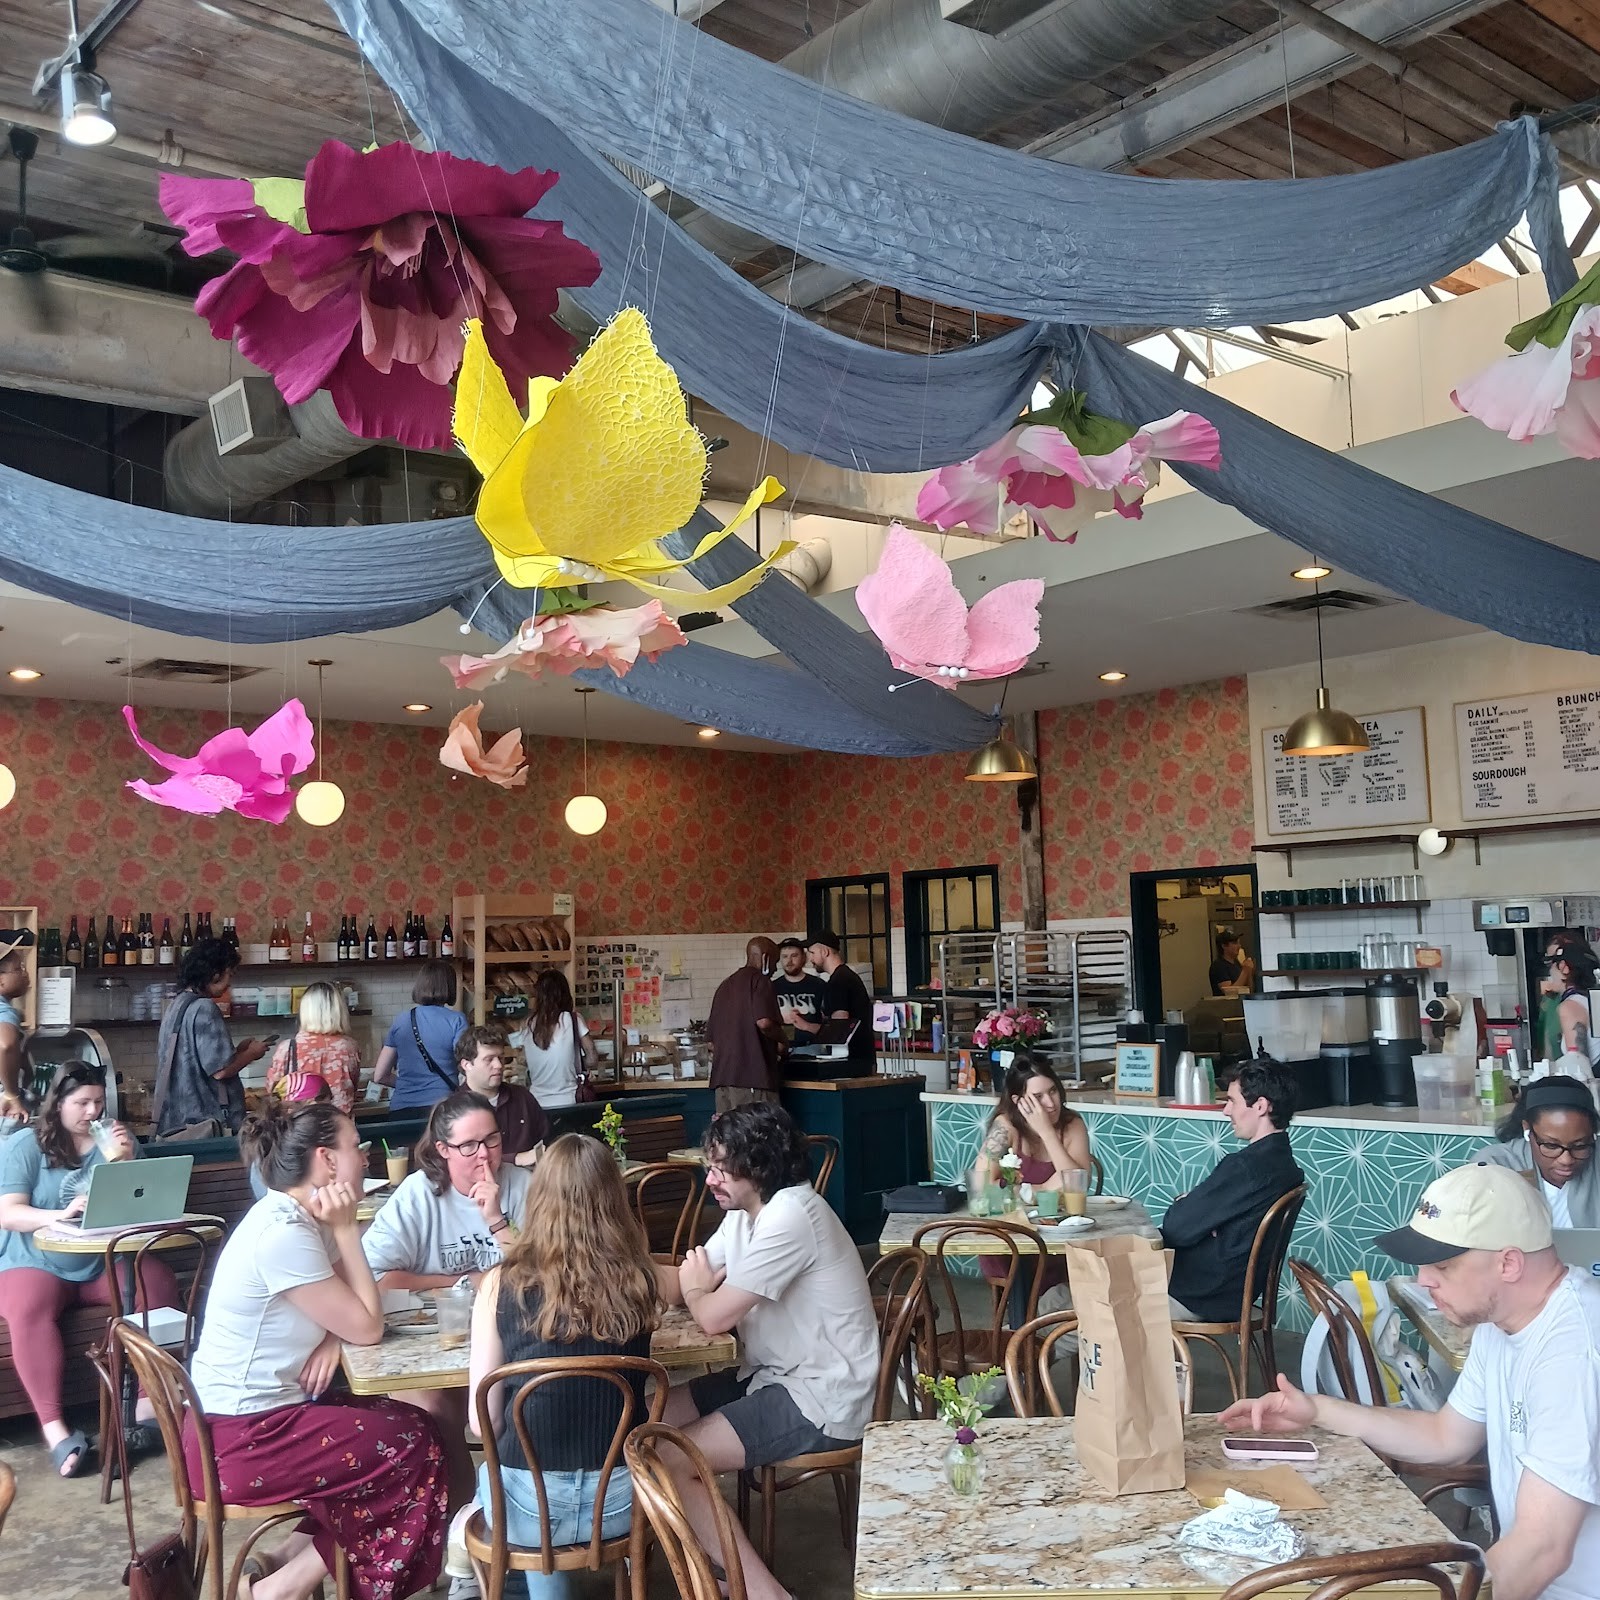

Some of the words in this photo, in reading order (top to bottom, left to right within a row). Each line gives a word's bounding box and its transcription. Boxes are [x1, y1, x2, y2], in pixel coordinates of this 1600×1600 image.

[1557, 691, 1600, 706] BRUNCH
[1468, 706, 1498, 718] DAILY
[1472, 767, 1526, 780] SOURDOUGH
[777, 993, 816, 1015] DUST
[441, 1249, 471, 1269] ROCKY
[471, 1249, 500, 1267] MOUNT
